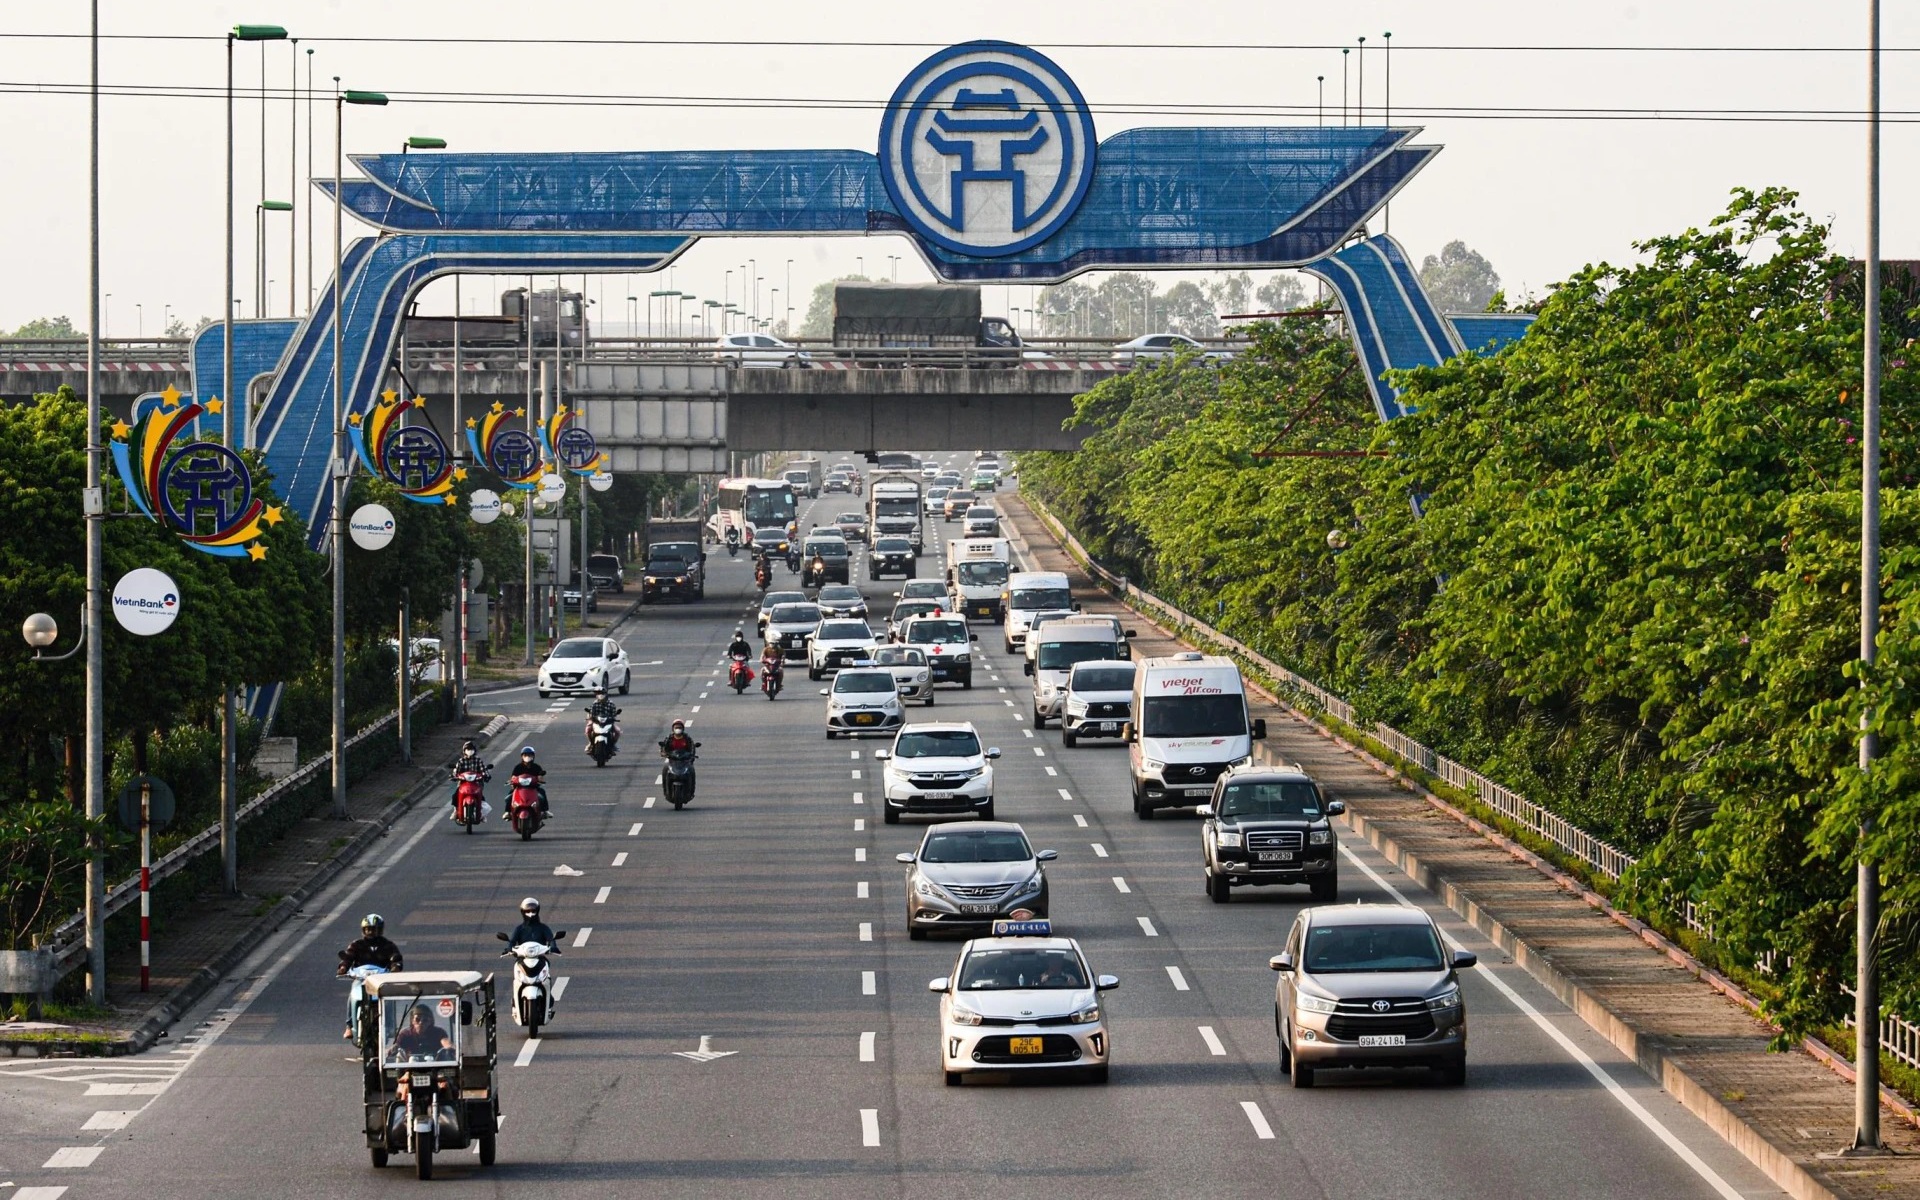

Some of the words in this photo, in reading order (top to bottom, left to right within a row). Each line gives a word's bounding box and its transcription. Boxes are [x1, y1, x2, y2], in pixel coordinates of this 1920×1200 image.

[350, 523, 385, 531] VietinBank
[114, 596, 164, 609] VietinBank
[1360, 1036, 1405, 1046] 99A-241.84
